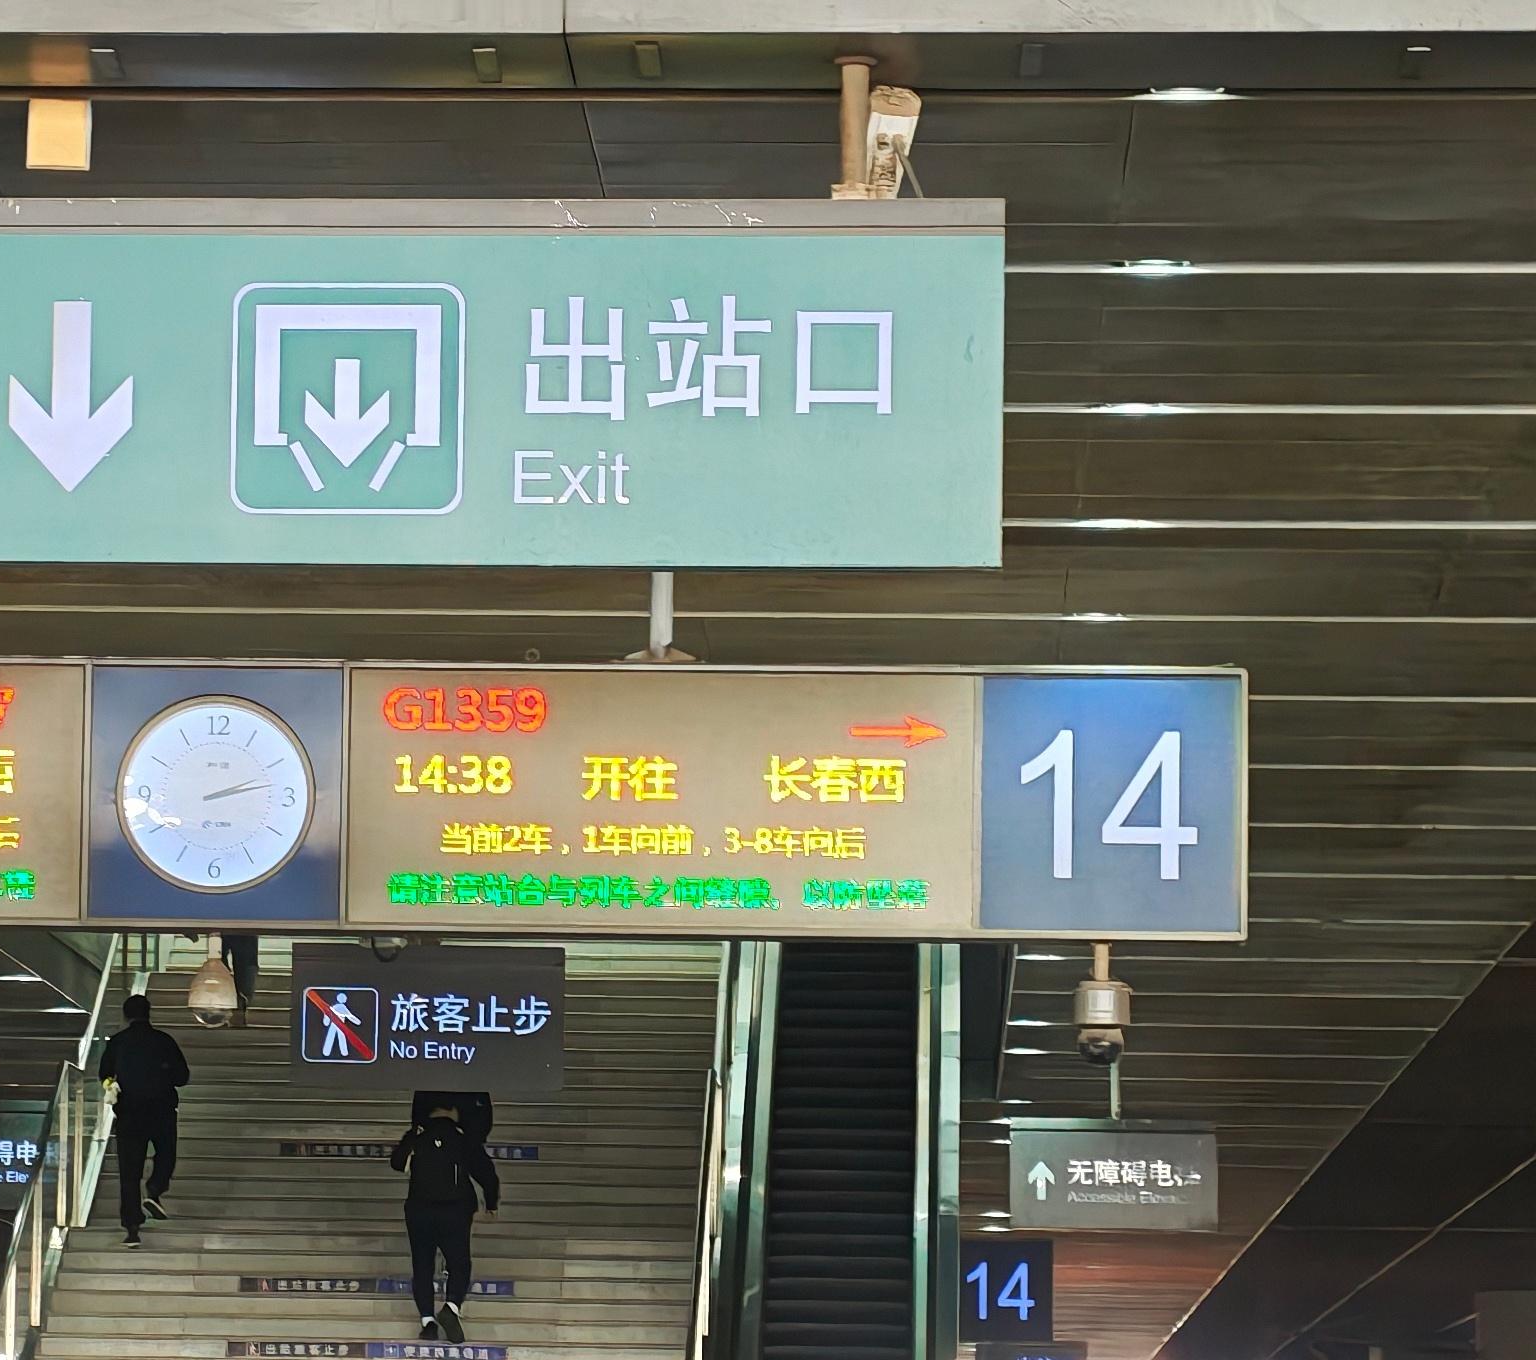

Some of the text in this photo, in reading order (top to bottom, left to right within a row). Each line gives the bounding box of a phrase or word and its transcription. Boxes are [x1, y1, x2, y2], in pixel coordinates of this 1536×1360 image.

[524, 295, 894, 421] 出站口
[512, 450, 631, 506] Exit
[207, 715, 231, 736] 12
[382, 686, 547, 733] G1359
[138, 785, 152, 803] 9
[282, 787, 296, 808] 3
[393, 754, 907, 805] 14:38 开往 长春西
[1019, 728, 1199, 880] 14
[207, 857, 221, 879] 6
[390, 993, 552, 1036] 旅客止步
[389, 1039, 476, 1065] No Entry
[966, 1261, 1036, 1321] 14
